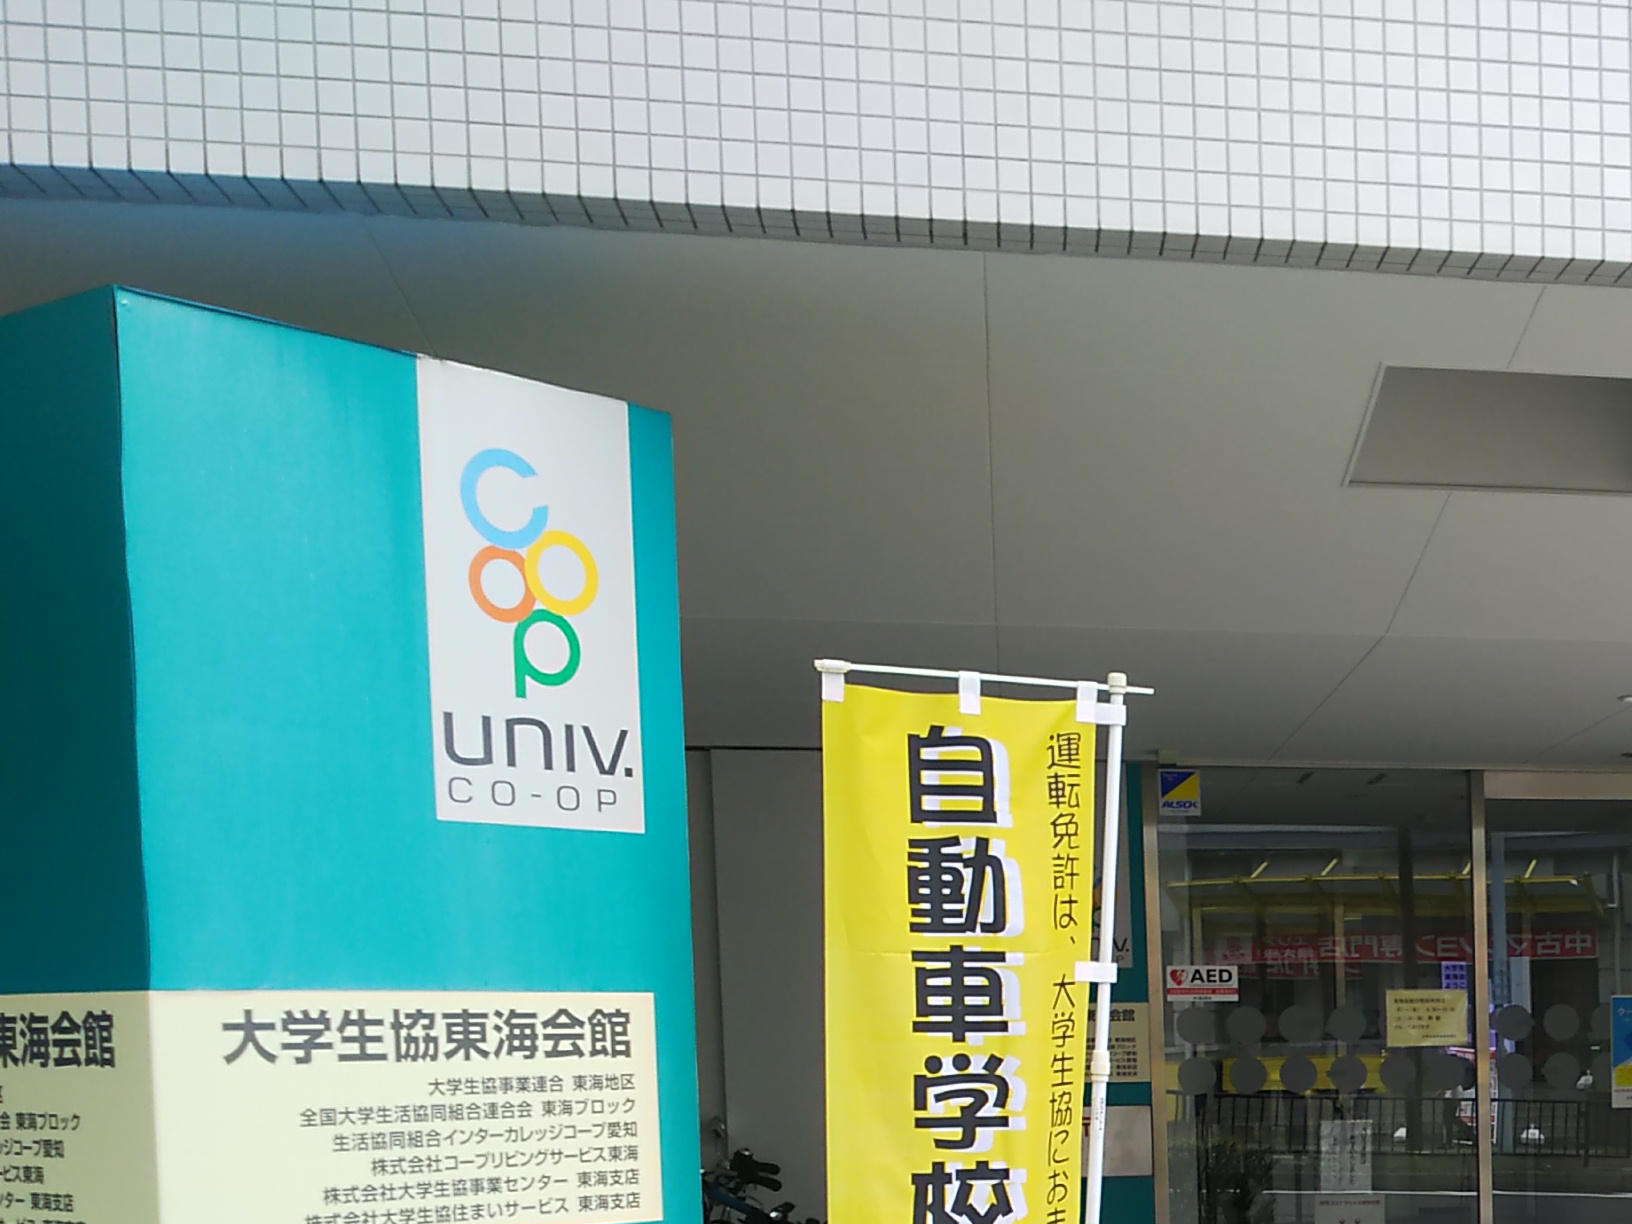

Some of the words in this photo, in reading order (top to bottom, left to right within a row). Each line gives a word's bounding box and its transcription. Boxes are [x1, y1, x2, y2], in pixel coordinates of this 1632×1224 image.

[443, 711, 634, 778] univ.
[448, 777, 617, 813] CO-OP
[1190, 969, 1233, 984] AED
[222, 1009, 633, 1064] 大学生協東海会館
[428, 1075, 564, 1096] 大学生協事業連合
[572, 1073, 636, 1092] 東海地区
[299, 1101, 533, 1128] 全国大学生活協同組合連合会
[541, 1098, 636, 1118] 東海ブロック
[332, 1121, 638, 1152] 生活協同組合インターカレッジコープ愛知
[371, 1145, 639, 1177] 株式会社コープリビングサービス東海
[323, 1177, 568, 1206] 株式会社大学生協事業センター
[577, 1169, 640, 1188] 東海支店
[578, 1192, 641, 1212] 東海支店
